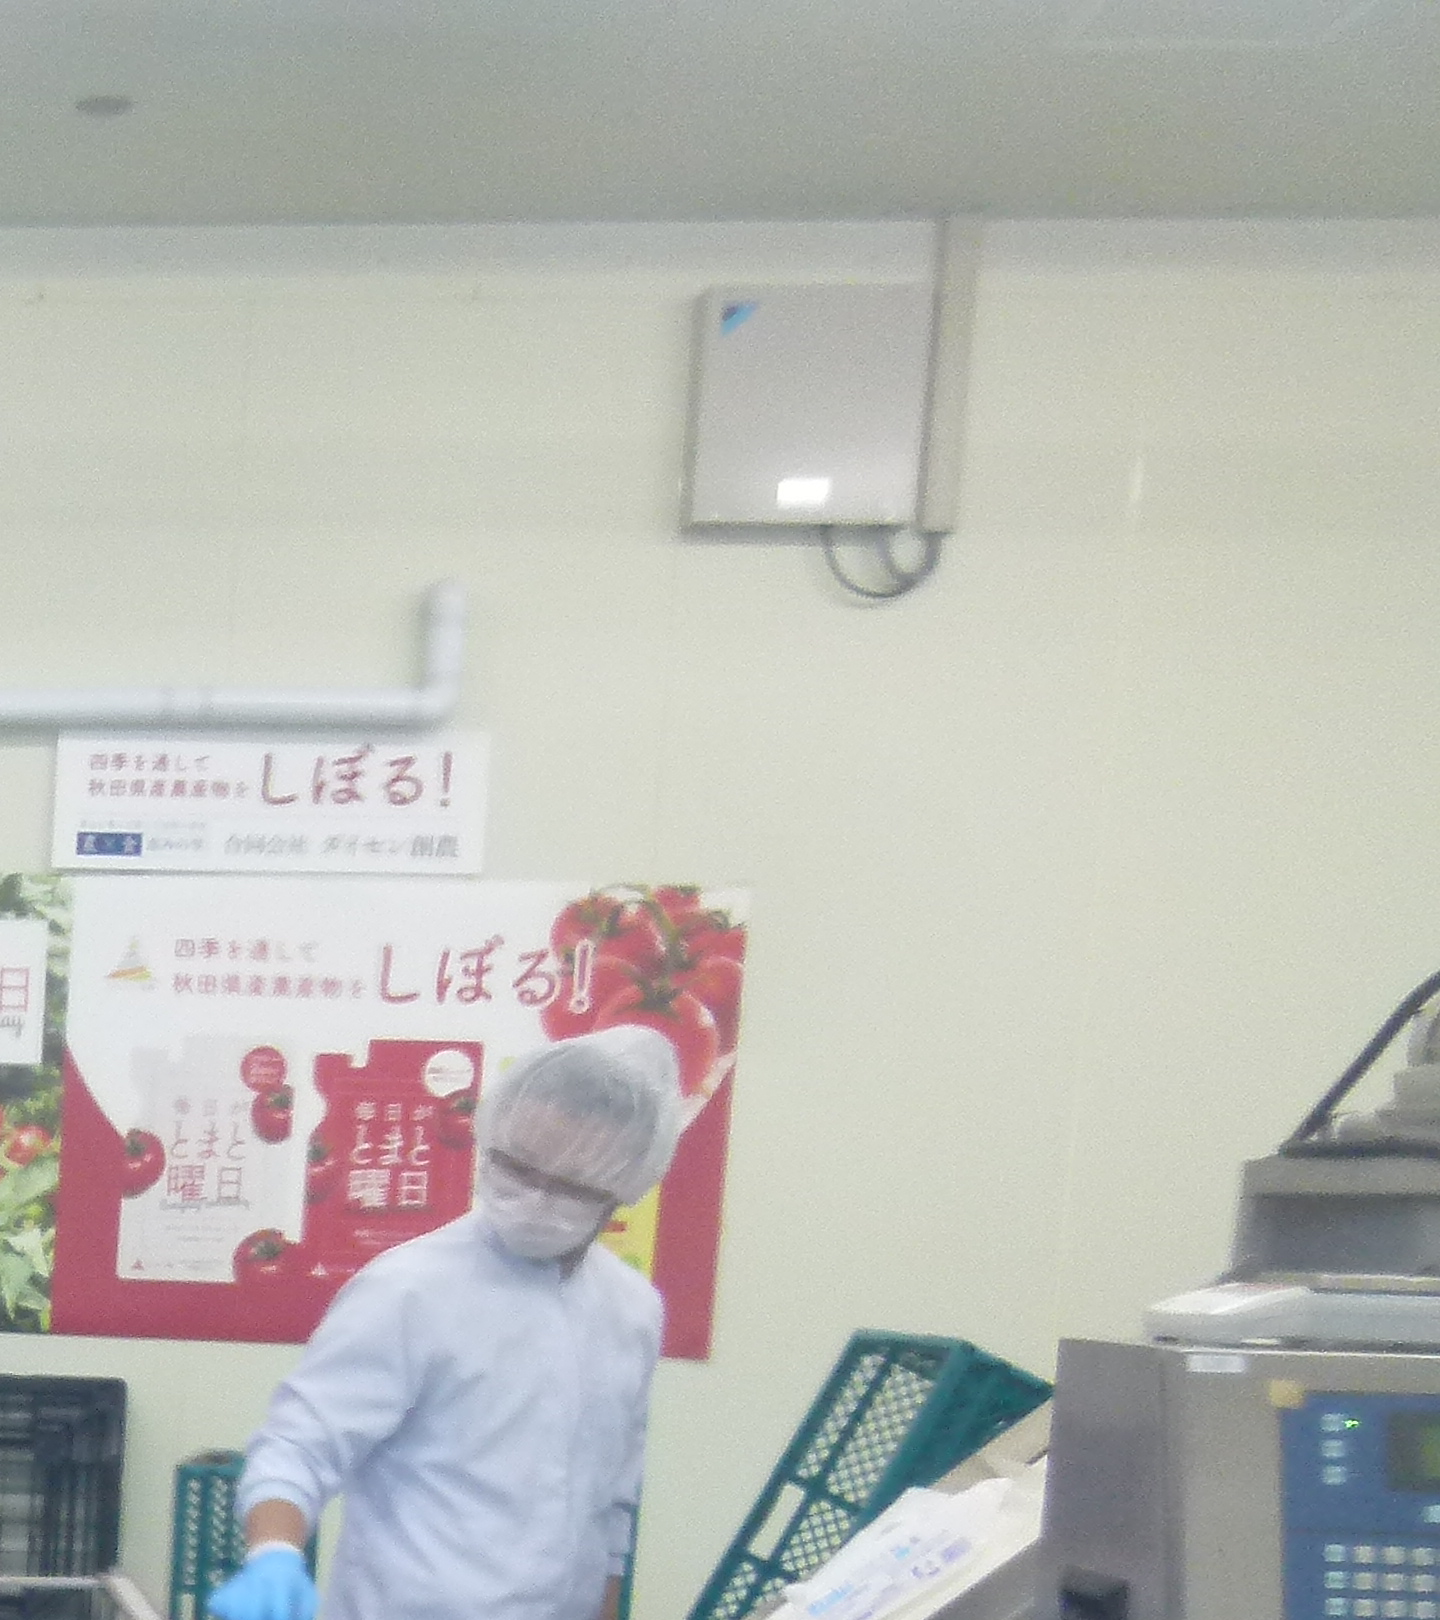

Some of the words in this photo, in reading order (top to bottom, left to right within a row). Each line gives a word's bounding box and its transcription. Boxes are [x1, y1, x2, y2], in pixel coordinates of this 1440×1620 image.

[260, 742, 453, 807] しぼる!
[381, 935, 593, 1014] しぼる!
